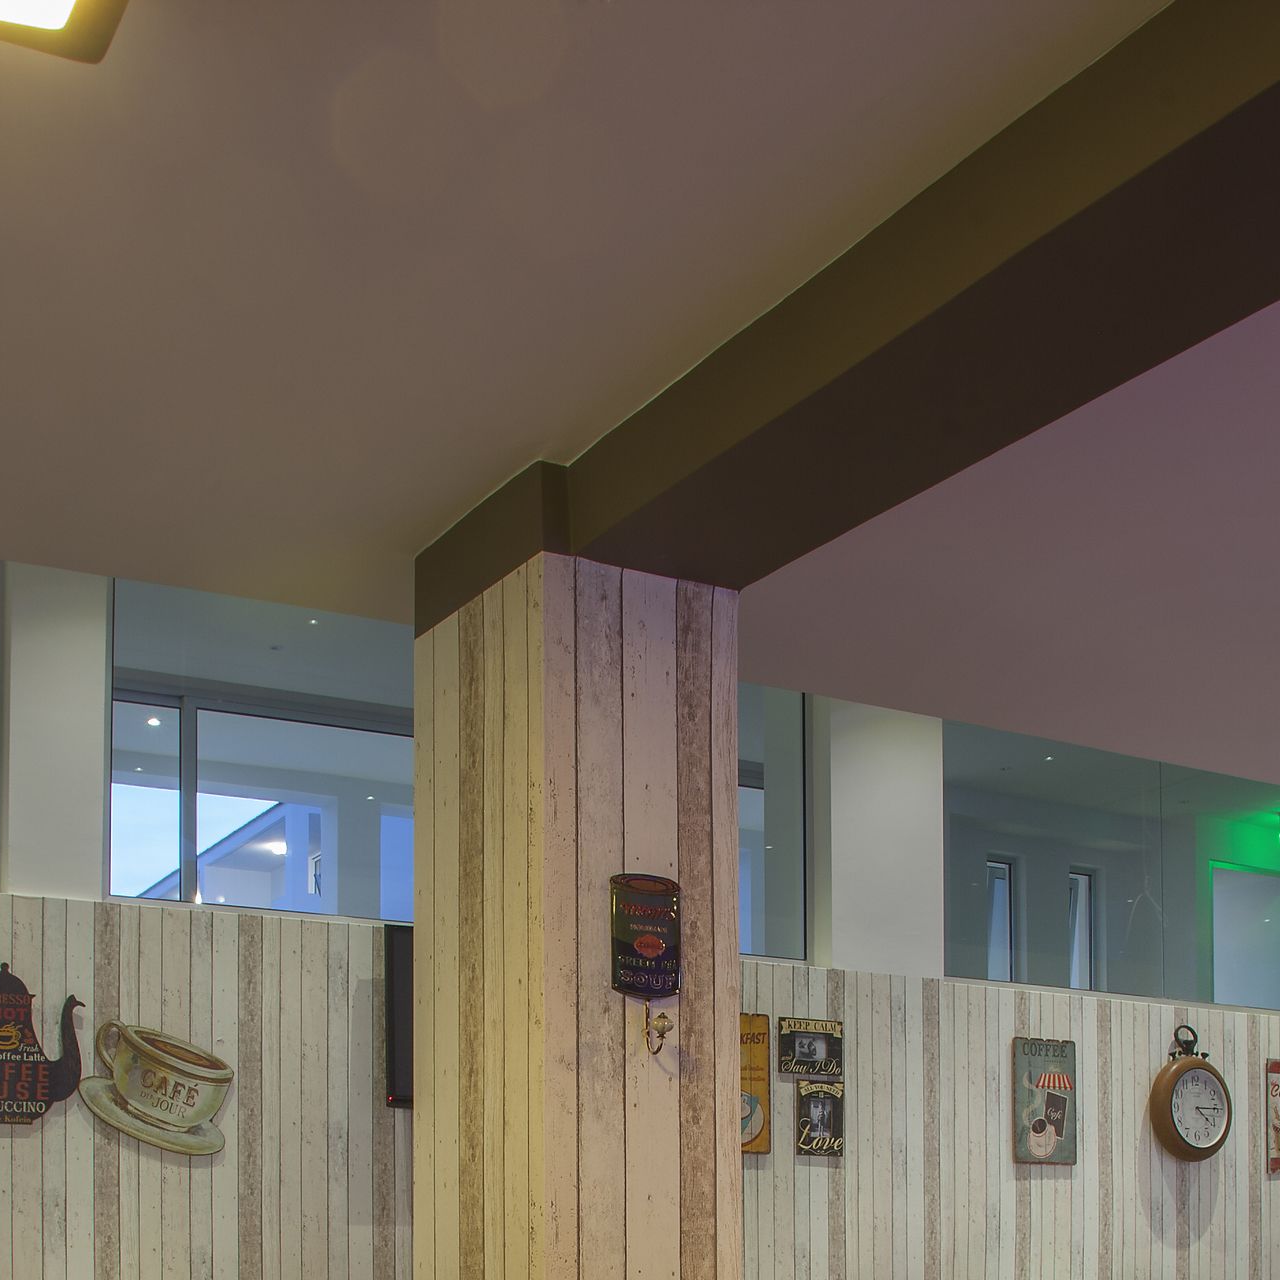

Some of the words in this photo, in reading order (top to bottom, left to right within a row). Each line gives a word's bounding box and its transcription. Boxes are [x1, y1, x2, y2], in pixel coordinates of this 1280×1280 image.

[787, 1020, 810, 1031] KEEP
[814, 1022, 837, 1032] CALM
[23, 1053, 46, 1062] Latte
[1023, 1042, 1067, 1058] COFFEE
[142, 1068, 199, 1107] CAFÉ
[152, 1098, 186, 1118] JOUR
[798, 1117, 843, 1150] Love
